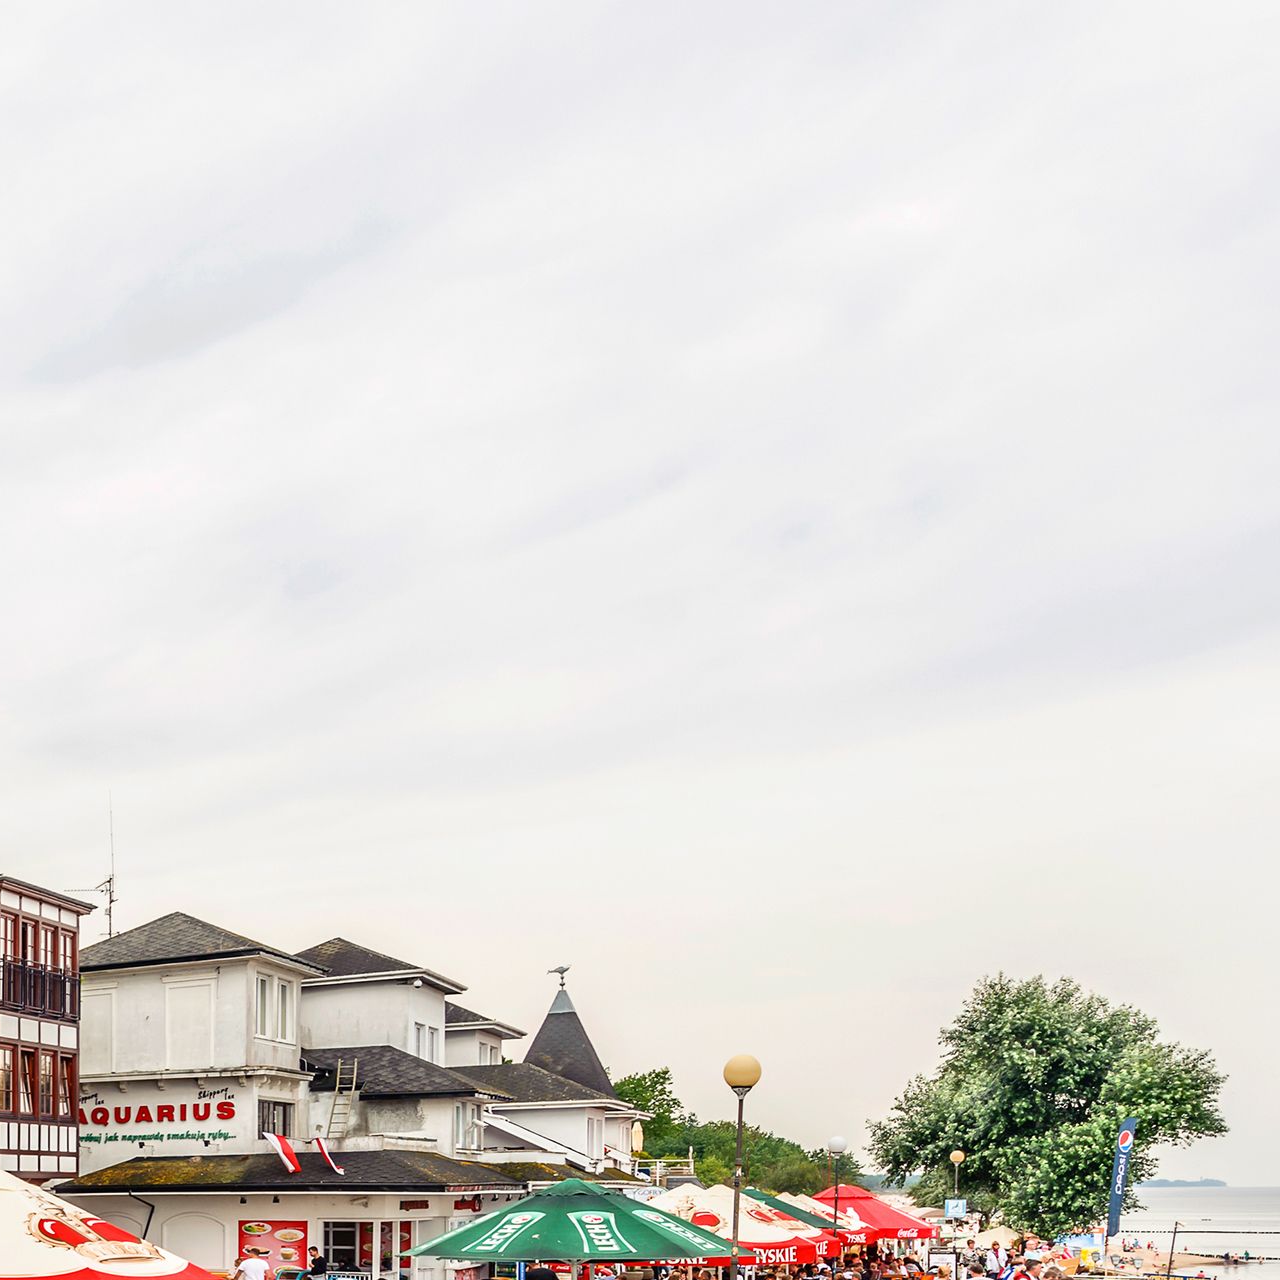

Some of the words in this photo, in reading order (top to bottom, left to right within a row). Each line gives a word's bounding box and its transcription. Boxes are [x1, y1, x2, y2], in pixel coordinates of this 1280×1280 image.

[104, 1132, 119, 1144] jak
[1115, 1154, 1126, 1195] pepsi
[475, 1224, 522, 1251] LECH
[584, 1224, 621, 1251] LECH
[753, 1246, 797, 1263] TYSKIE
